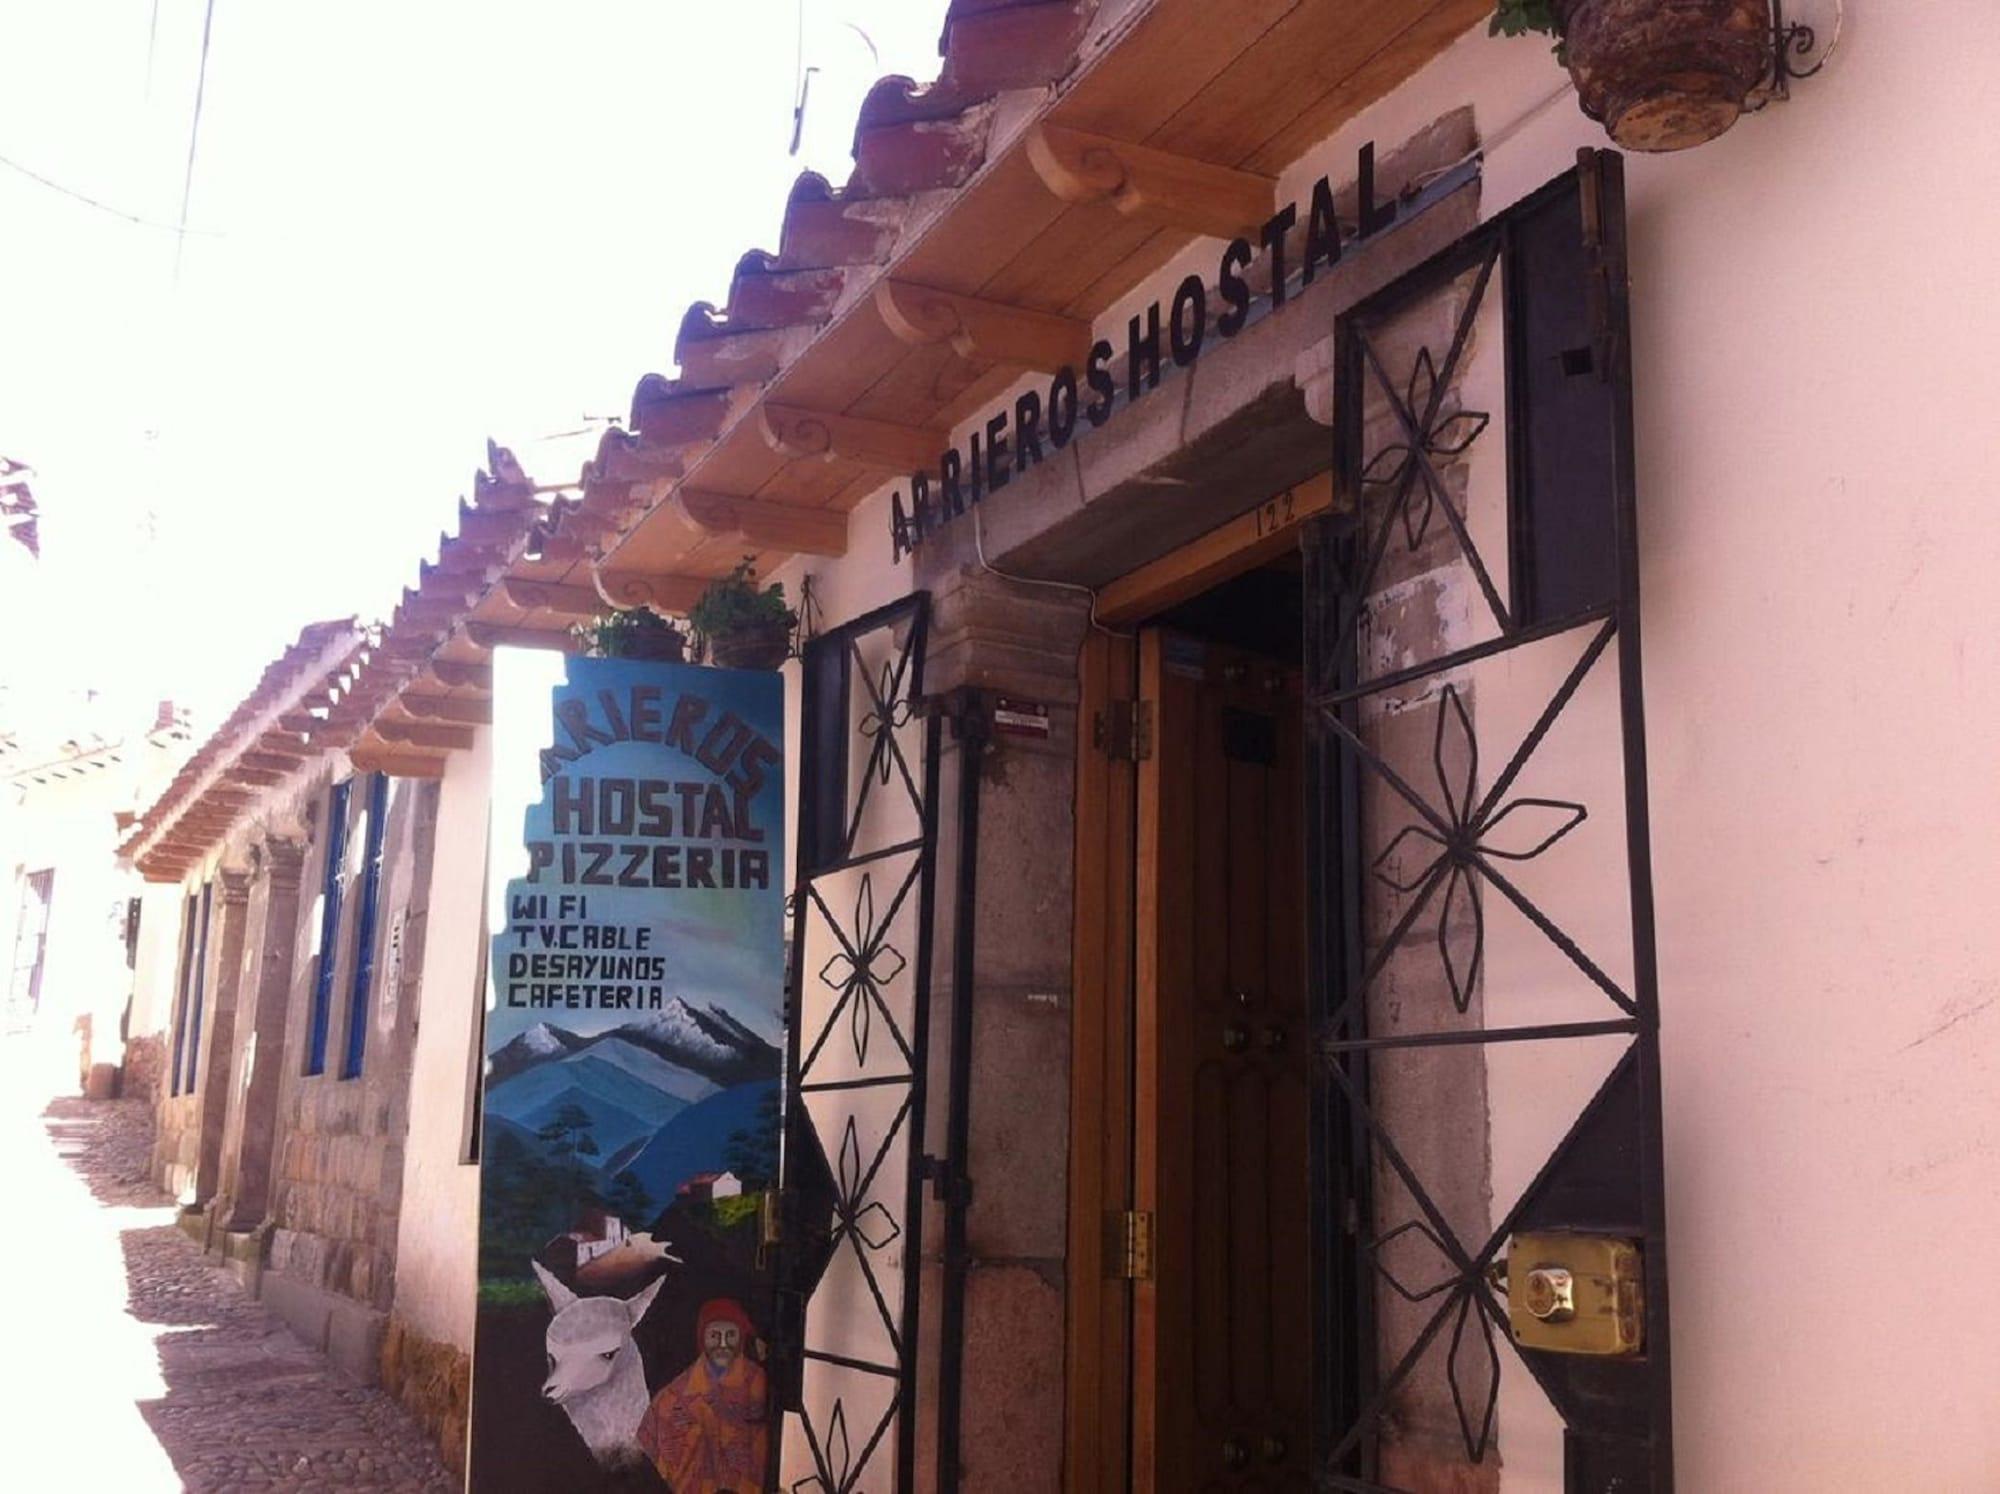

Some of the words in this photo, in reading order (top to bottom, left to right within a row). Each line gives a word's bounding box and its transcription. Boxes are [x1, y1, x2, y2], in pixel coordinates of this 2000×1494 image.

[1256, 491, 1296, 537] 122
[553, 777, 765, 843] HOSTAL
[527, 842, 769, 889] PIZZERIA
[509, 953, 666, 981] DESAYUNOS
[508, 983, 662, 1010] CAFETERIA
